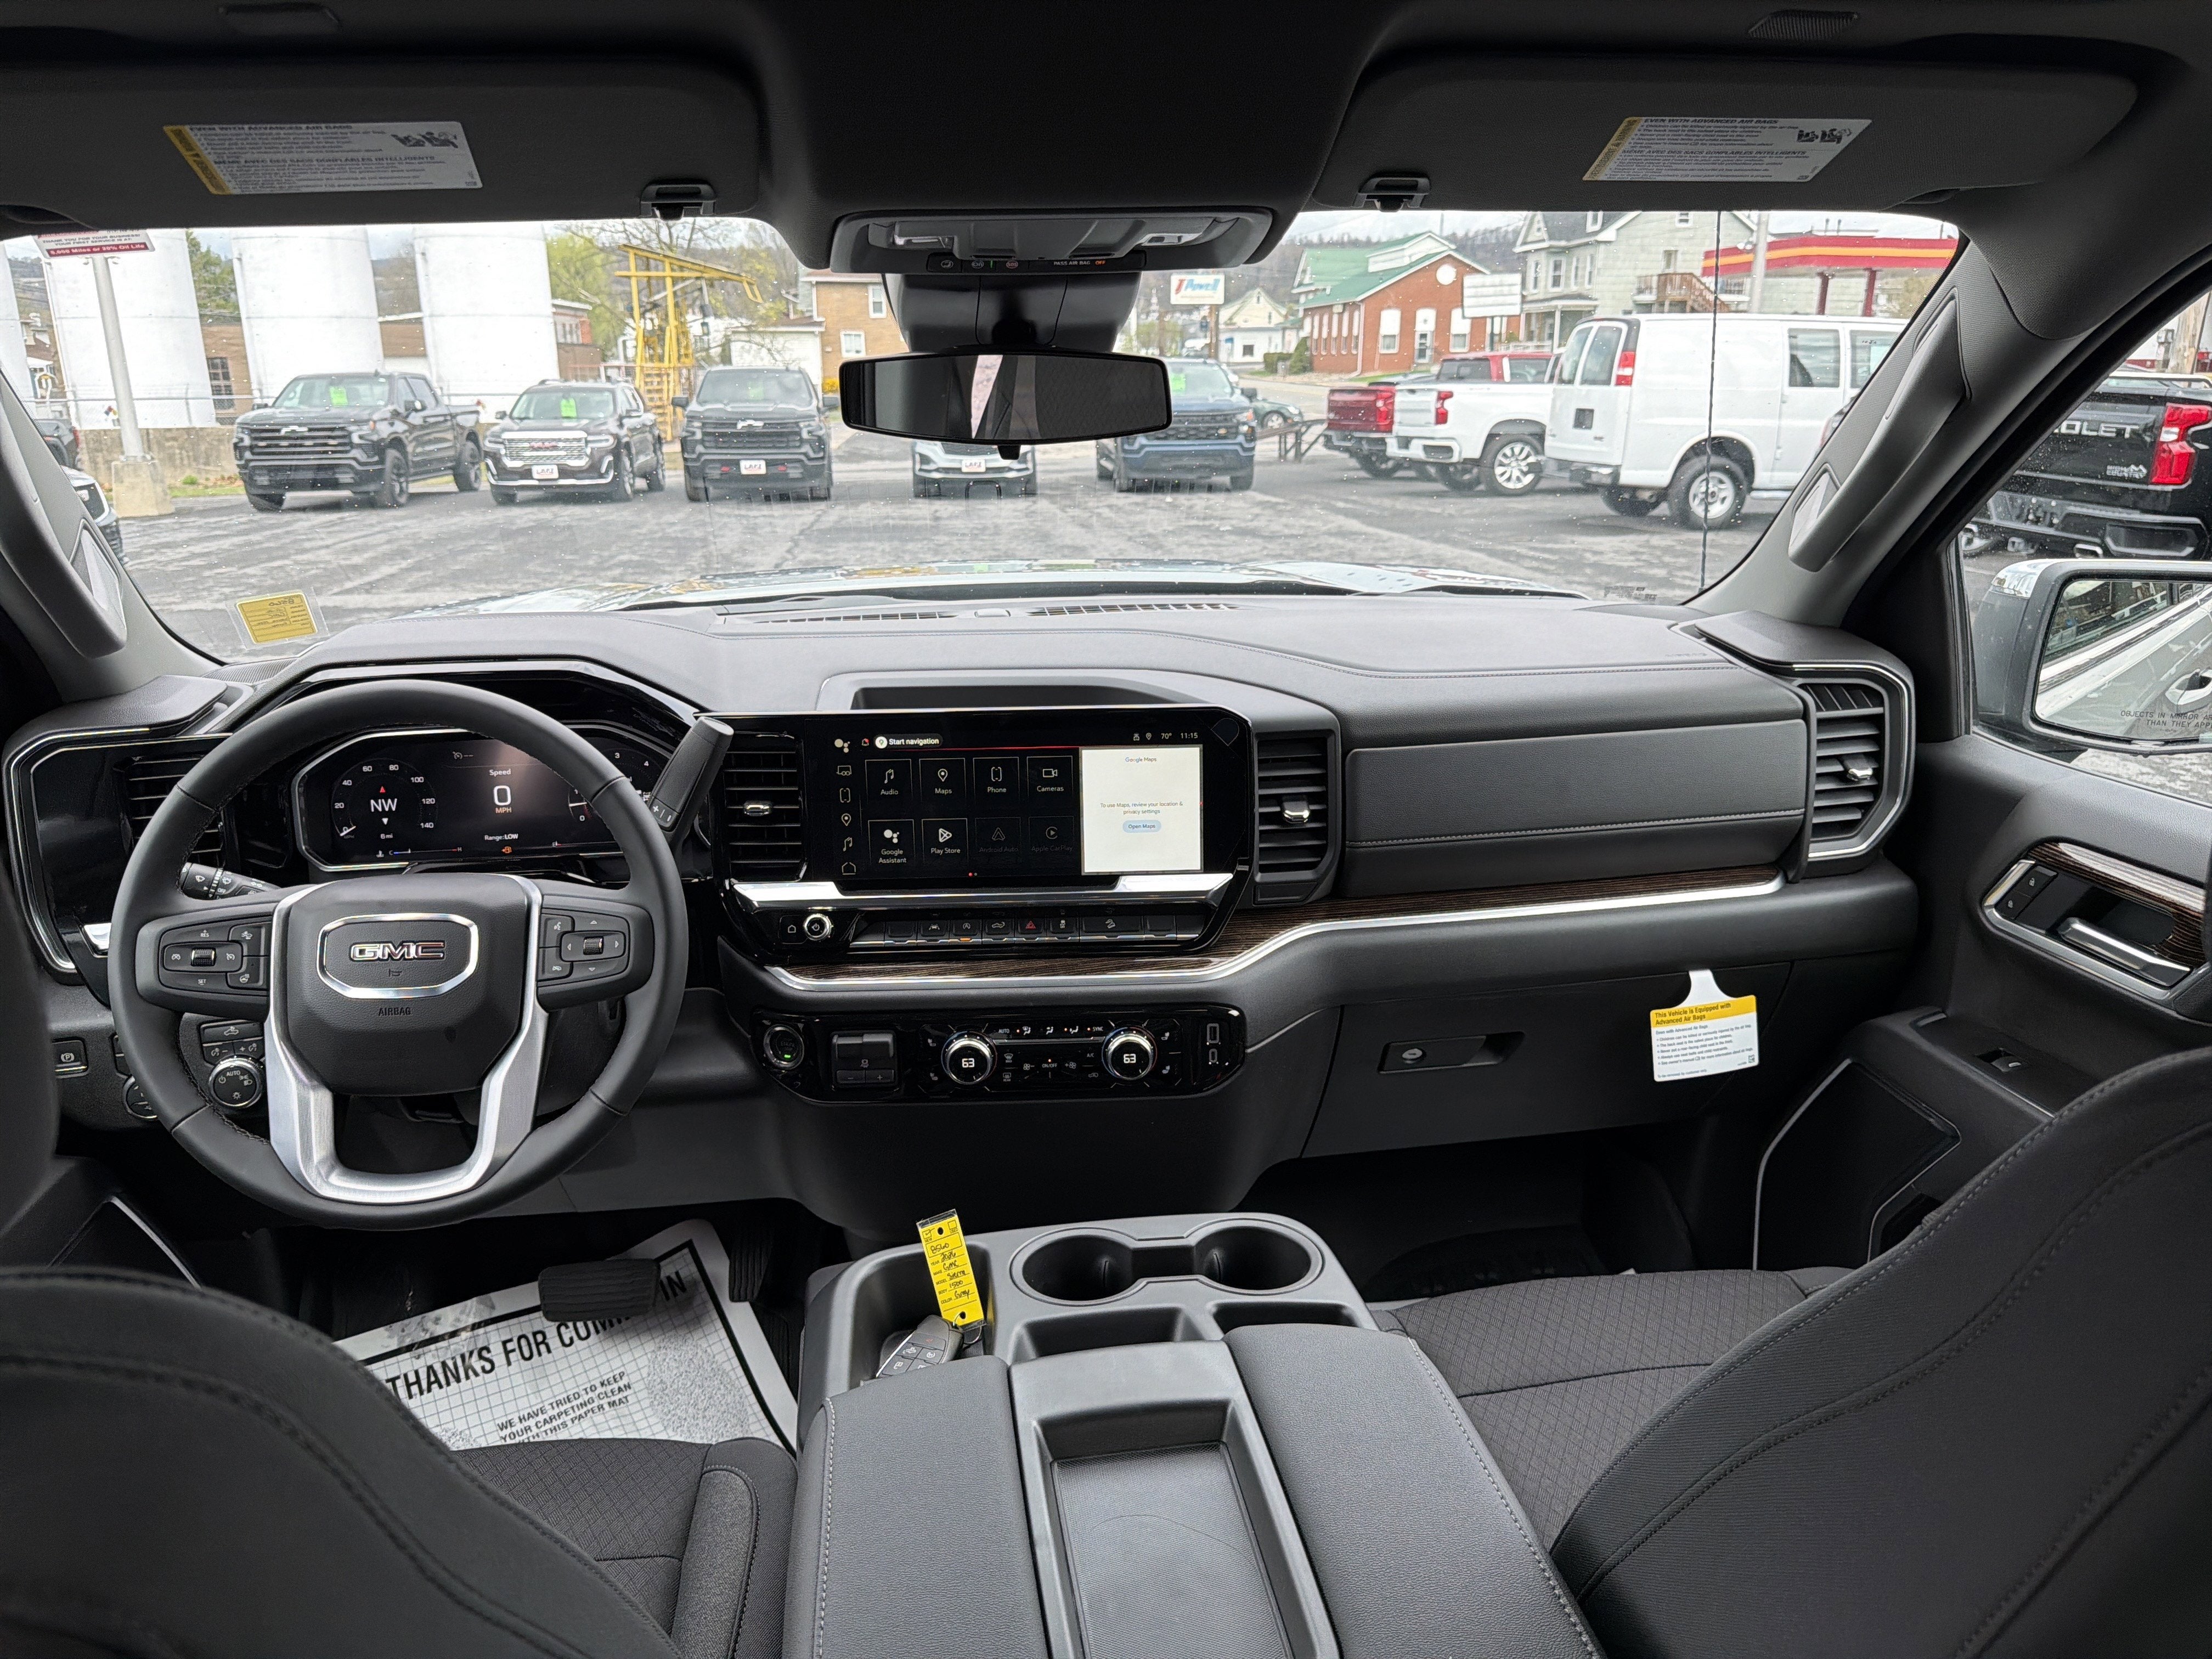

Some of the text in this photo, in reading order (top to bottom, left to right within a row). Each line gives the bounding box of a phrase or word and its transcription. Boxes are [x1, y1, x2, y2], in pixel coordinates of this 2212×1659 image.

[2053, 420, 2140, 439] OLET
[2120, 710, 2154, 718] OBJECTS
[906, 737, 940, 746] navigation
[488, 768, 511, 777] Speed
[493, 785, 511, 806] 0
[935, 787, 952, 795] Maps
[370, 798, 398, 812] NW
[881, 848, 904, 857] Google
[930, 847, 944, 856] Play
[349, 941, 445, 961] GMC
[378, 1007, 411, 1016] AIRBAG
[1695, 1003, 1719, 1014] Equipped
[1655, 1017, 1683, 1026] Advanced
[962, 1058, 975, 1068] 63
[1123, 1053, 1136, 1064] 63
[949, 1279, 963, 1289] 1500
[386, 1348, 495, 1400] THANKS
[500, 1329, 552, 1367] FOR
[659, 1271, 687, 1302] IN
[497, 1370, 625, 1432] WE HAVE TRIED TO KEEP
[500, 1381, 632, 1443] YOUR CARPETING CLEAN
[543, 1420, 568, 1436] THIS
[571, 1403, 606, 1424] PAPER
[607, 1395, 630, 1408] MAT
